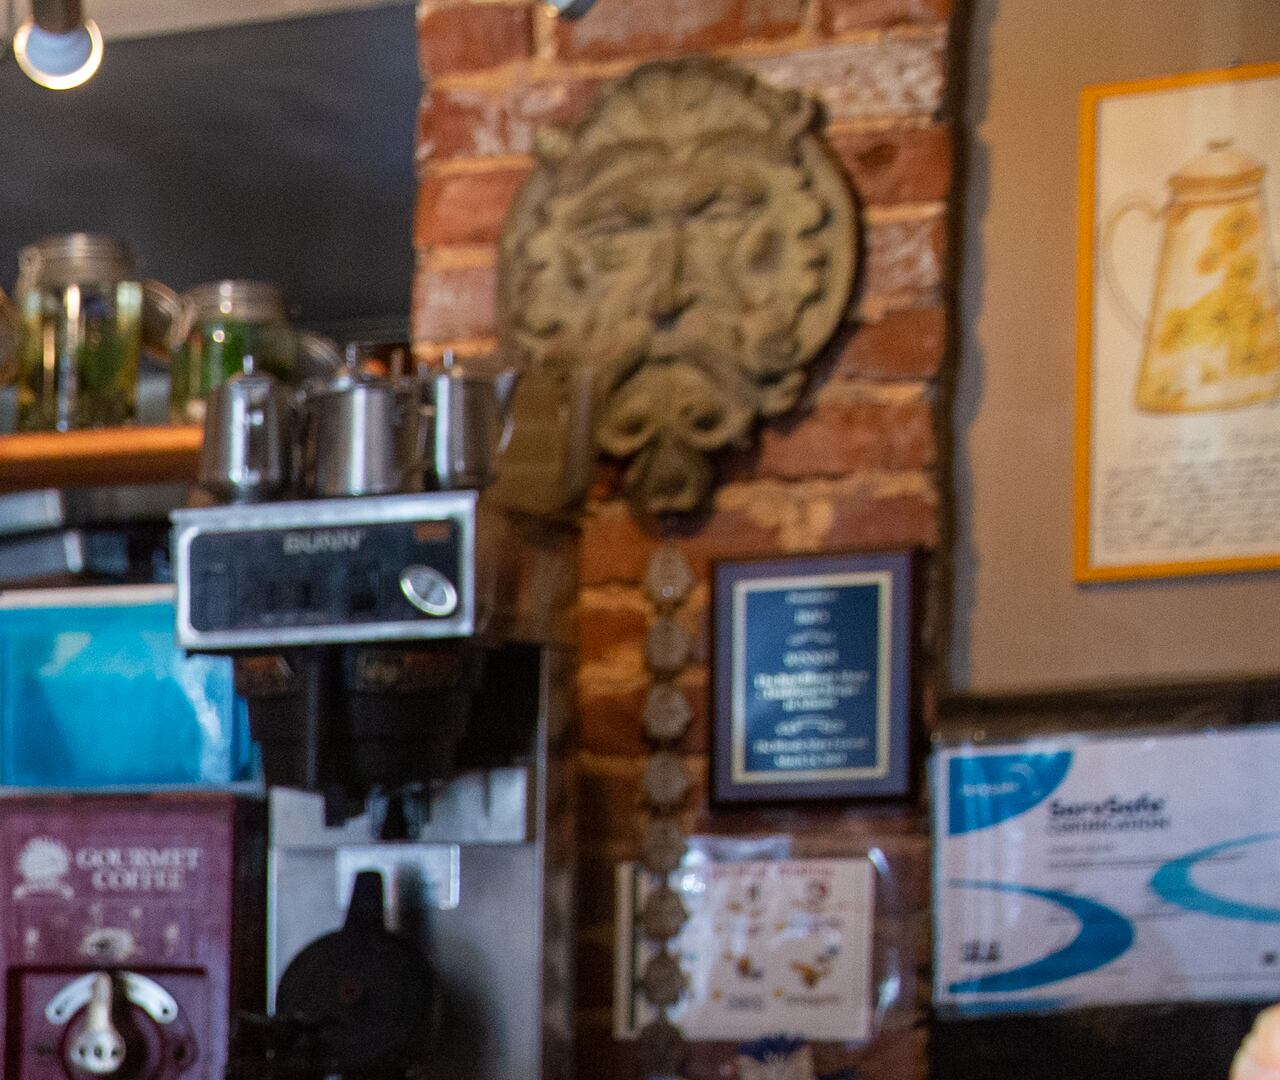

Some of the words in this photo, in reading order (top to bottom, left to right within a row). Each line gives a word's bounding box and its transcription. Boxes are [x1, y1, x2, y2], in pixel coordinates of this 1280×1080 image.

[283, 530, 366, 554] BUNN
[76, 848, 198, 869] GOURMET
[92, 870, 184, 891] COFFEE
